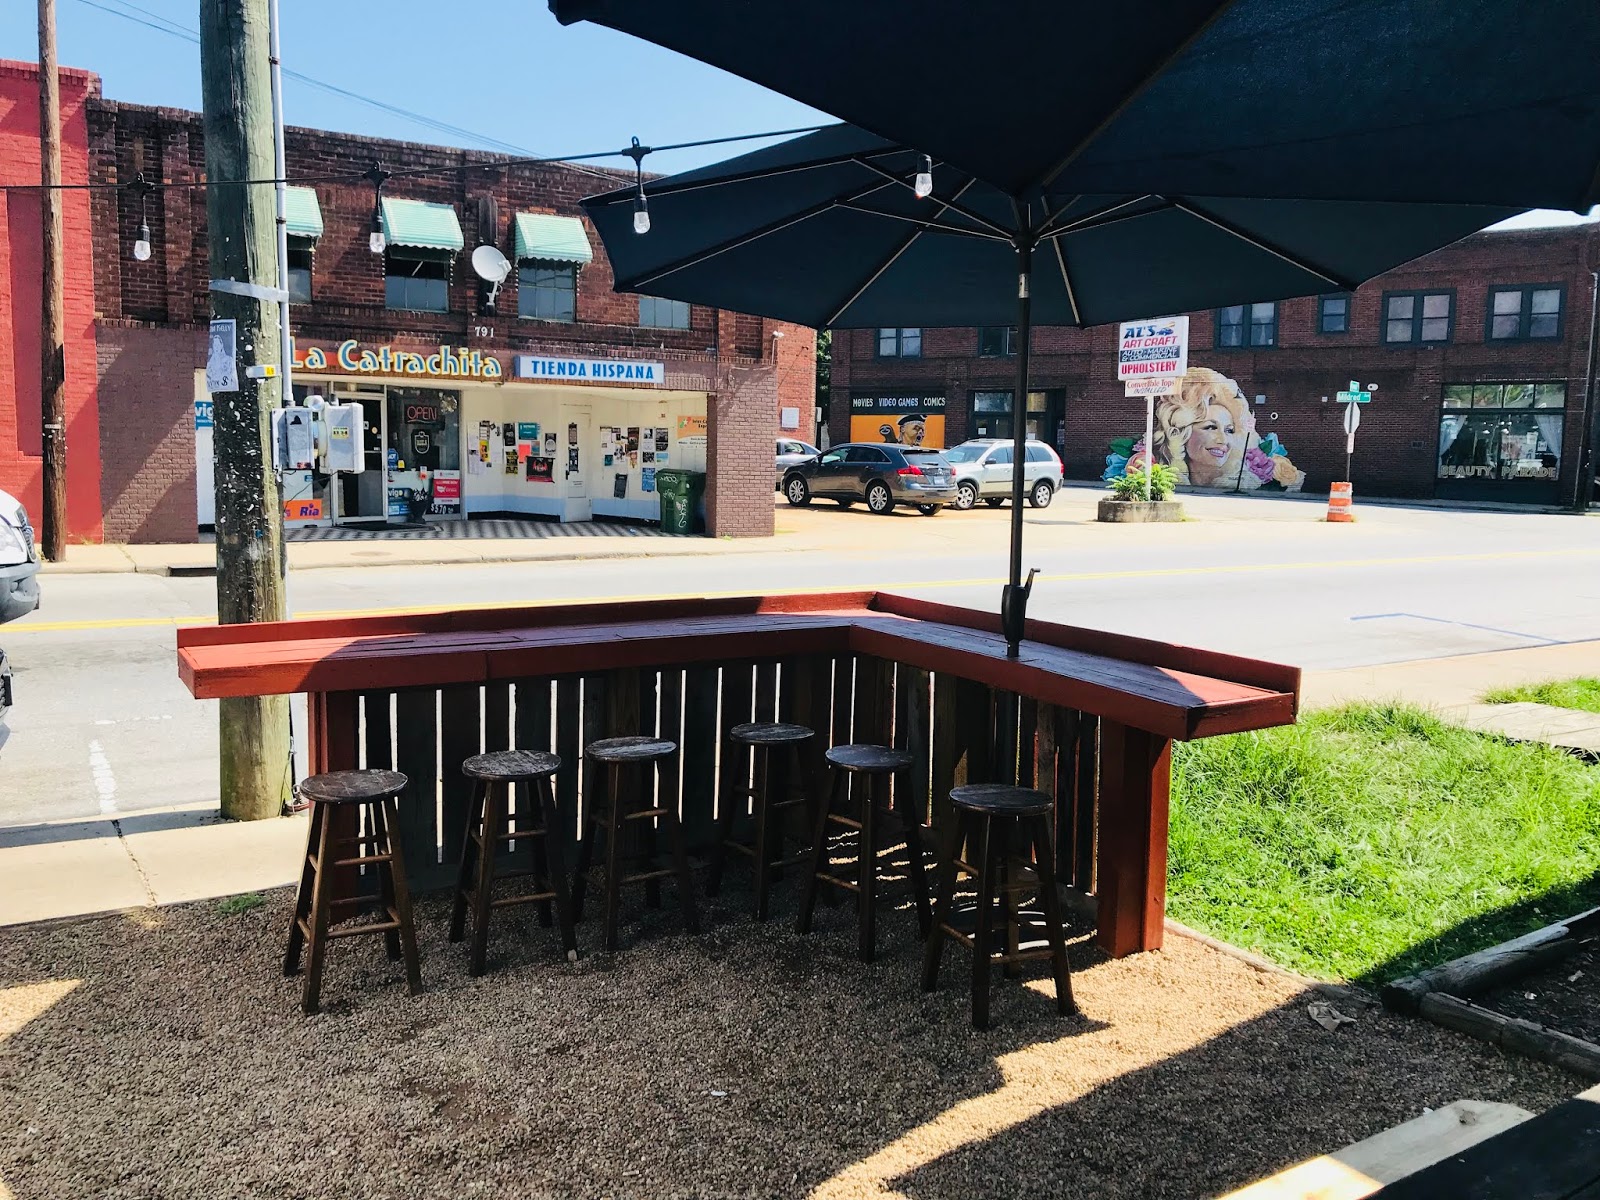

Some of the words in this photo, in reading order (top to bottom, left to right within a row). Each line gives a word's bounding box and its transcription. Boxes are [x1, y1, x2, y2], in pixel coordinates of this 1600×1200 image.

[474, 326, 494, 338] 791
[1123, 325, 1157, 339] AL'S
[1123, 339, 1143, 349] ART
[1144, 336, 1178, 347] CRAFT
[289, 336, 327, 369] La
[337, 339, 503, 378] Catrachita
[532, 360, 587, 377] TIENDA
[592, 363, 654, 380] HISPANA
[1121, 361, 1177, 375] UPHOLSTERY
[852, 398, 874, 408] MOVIES
[878, 397, 897, 407] VIDEO
[898, 397, 919, 407] GAMES
[923, 397, 946, 407] COMICS
[195, 403, 214, 420] vig
[407, 406, 437, 420] OPEN
[1441, 465, 1493, 477] BEAUTY
[1501, 466, 1557, 478] PARADE
[300, 503, 320, 517] Ria
